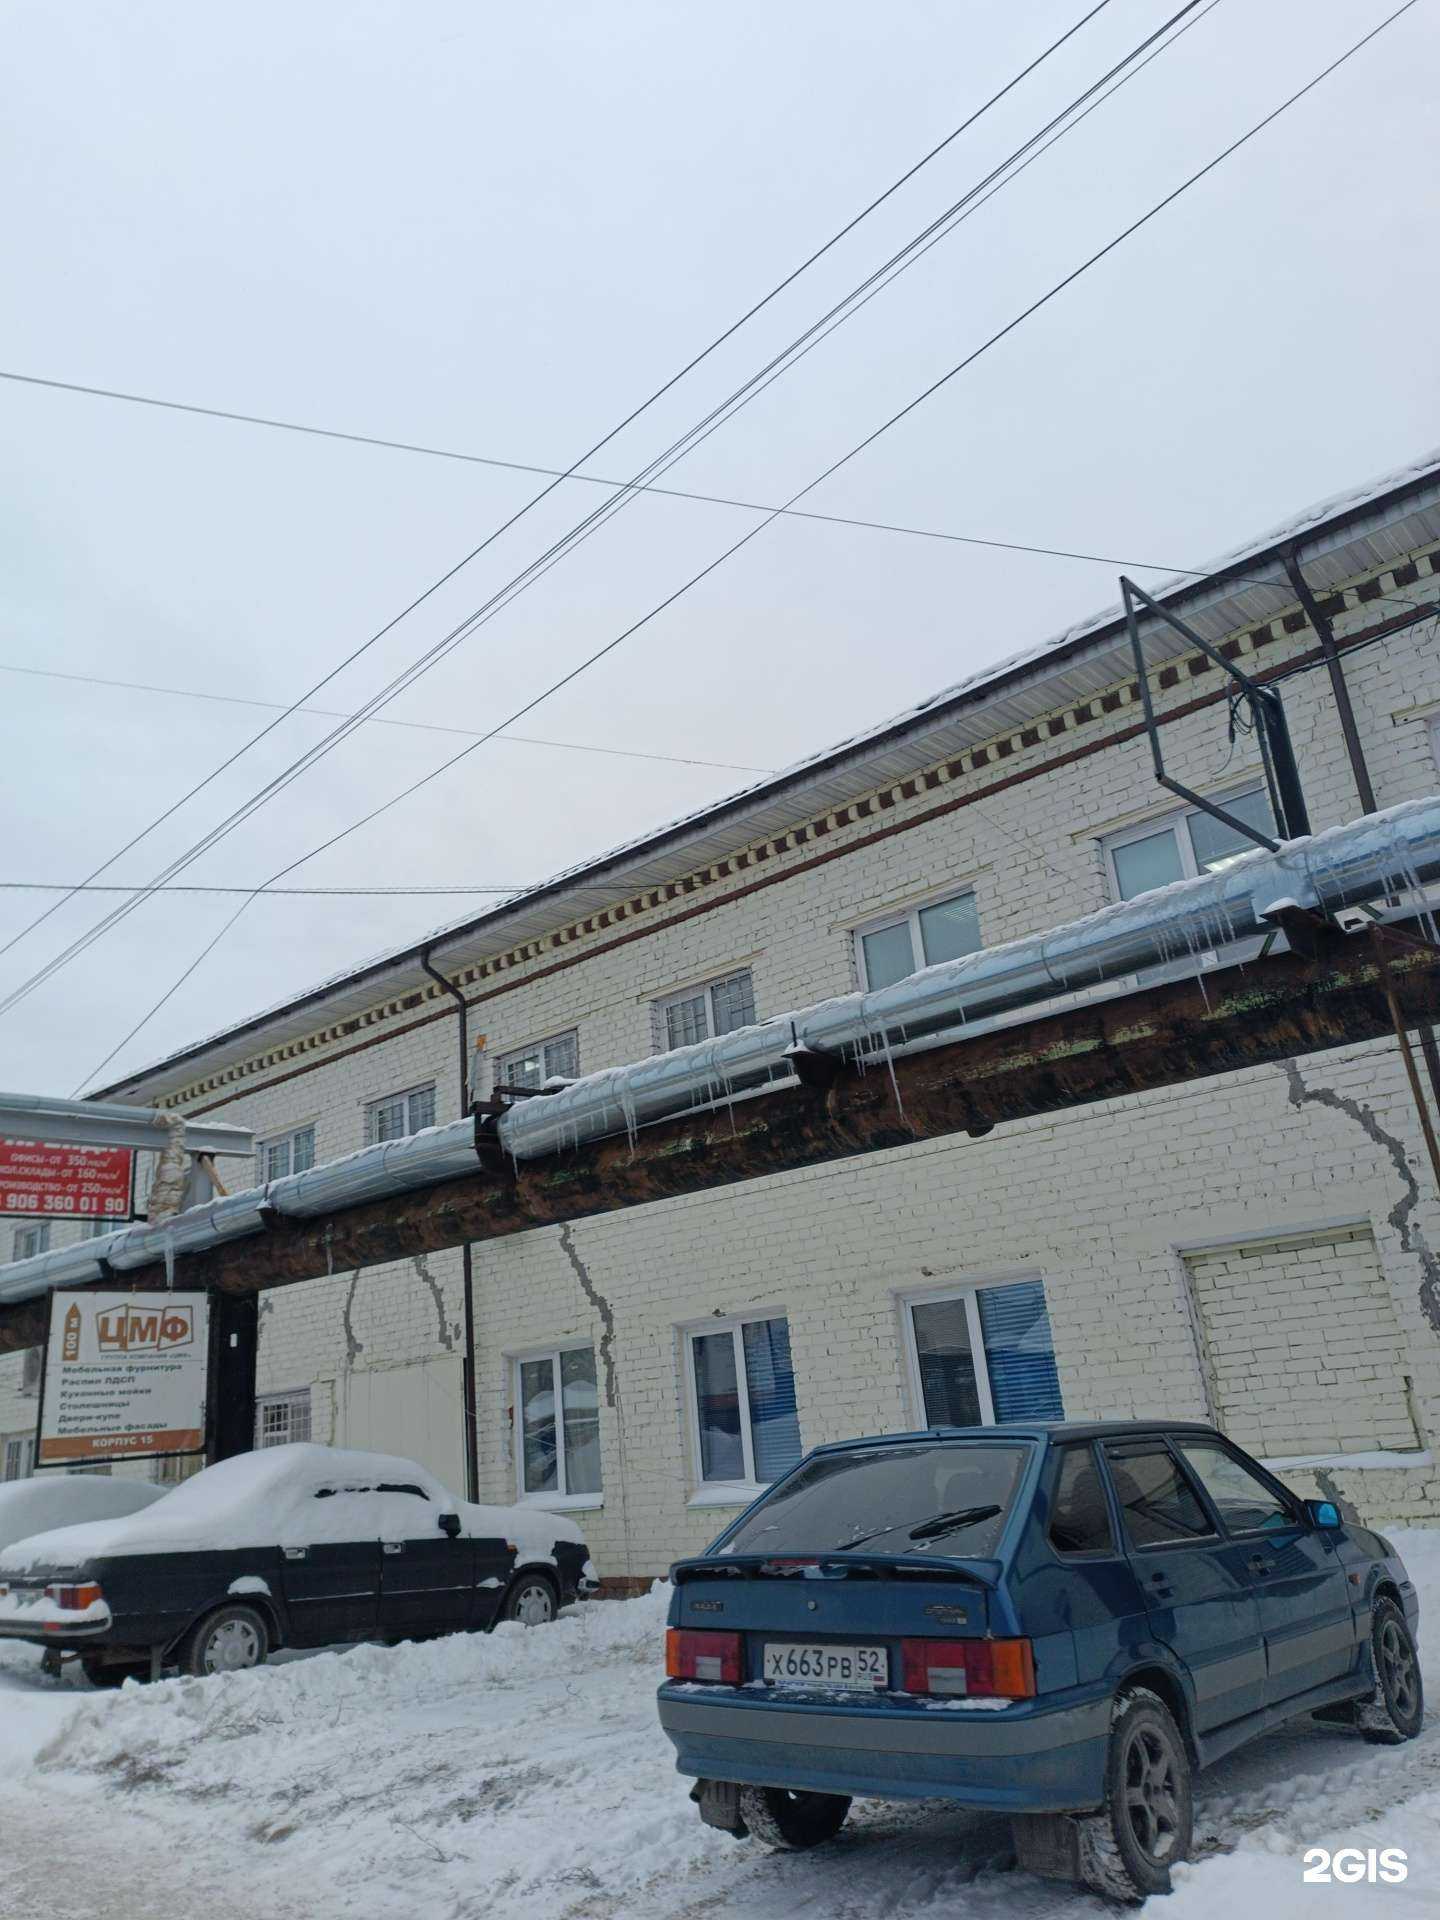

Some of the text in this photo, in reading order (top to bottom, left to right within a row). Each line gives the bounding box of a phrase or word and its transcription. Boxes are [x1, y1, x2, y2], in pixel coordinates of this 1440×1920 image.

[6, 1193, 38, 1209] 906
[43, 1194, 74, 1210] 360
[80, 1196, 98, 1211] 01
[104, 1197, 125, 1212] 90
[99, 1316, 189, 1352] ЦМФ
[65, 1332, 77, 1356] 100
[62, 1364, 182, 1374] Мебельная фурнитура
[105, 1376, 136, 1385] ЛДСП
[59, 1401, 130, 1411] Столешницы
[124, 1422, 168, 1432] фасады
[91, 1435, 153, 1448] КОРПУС 15
